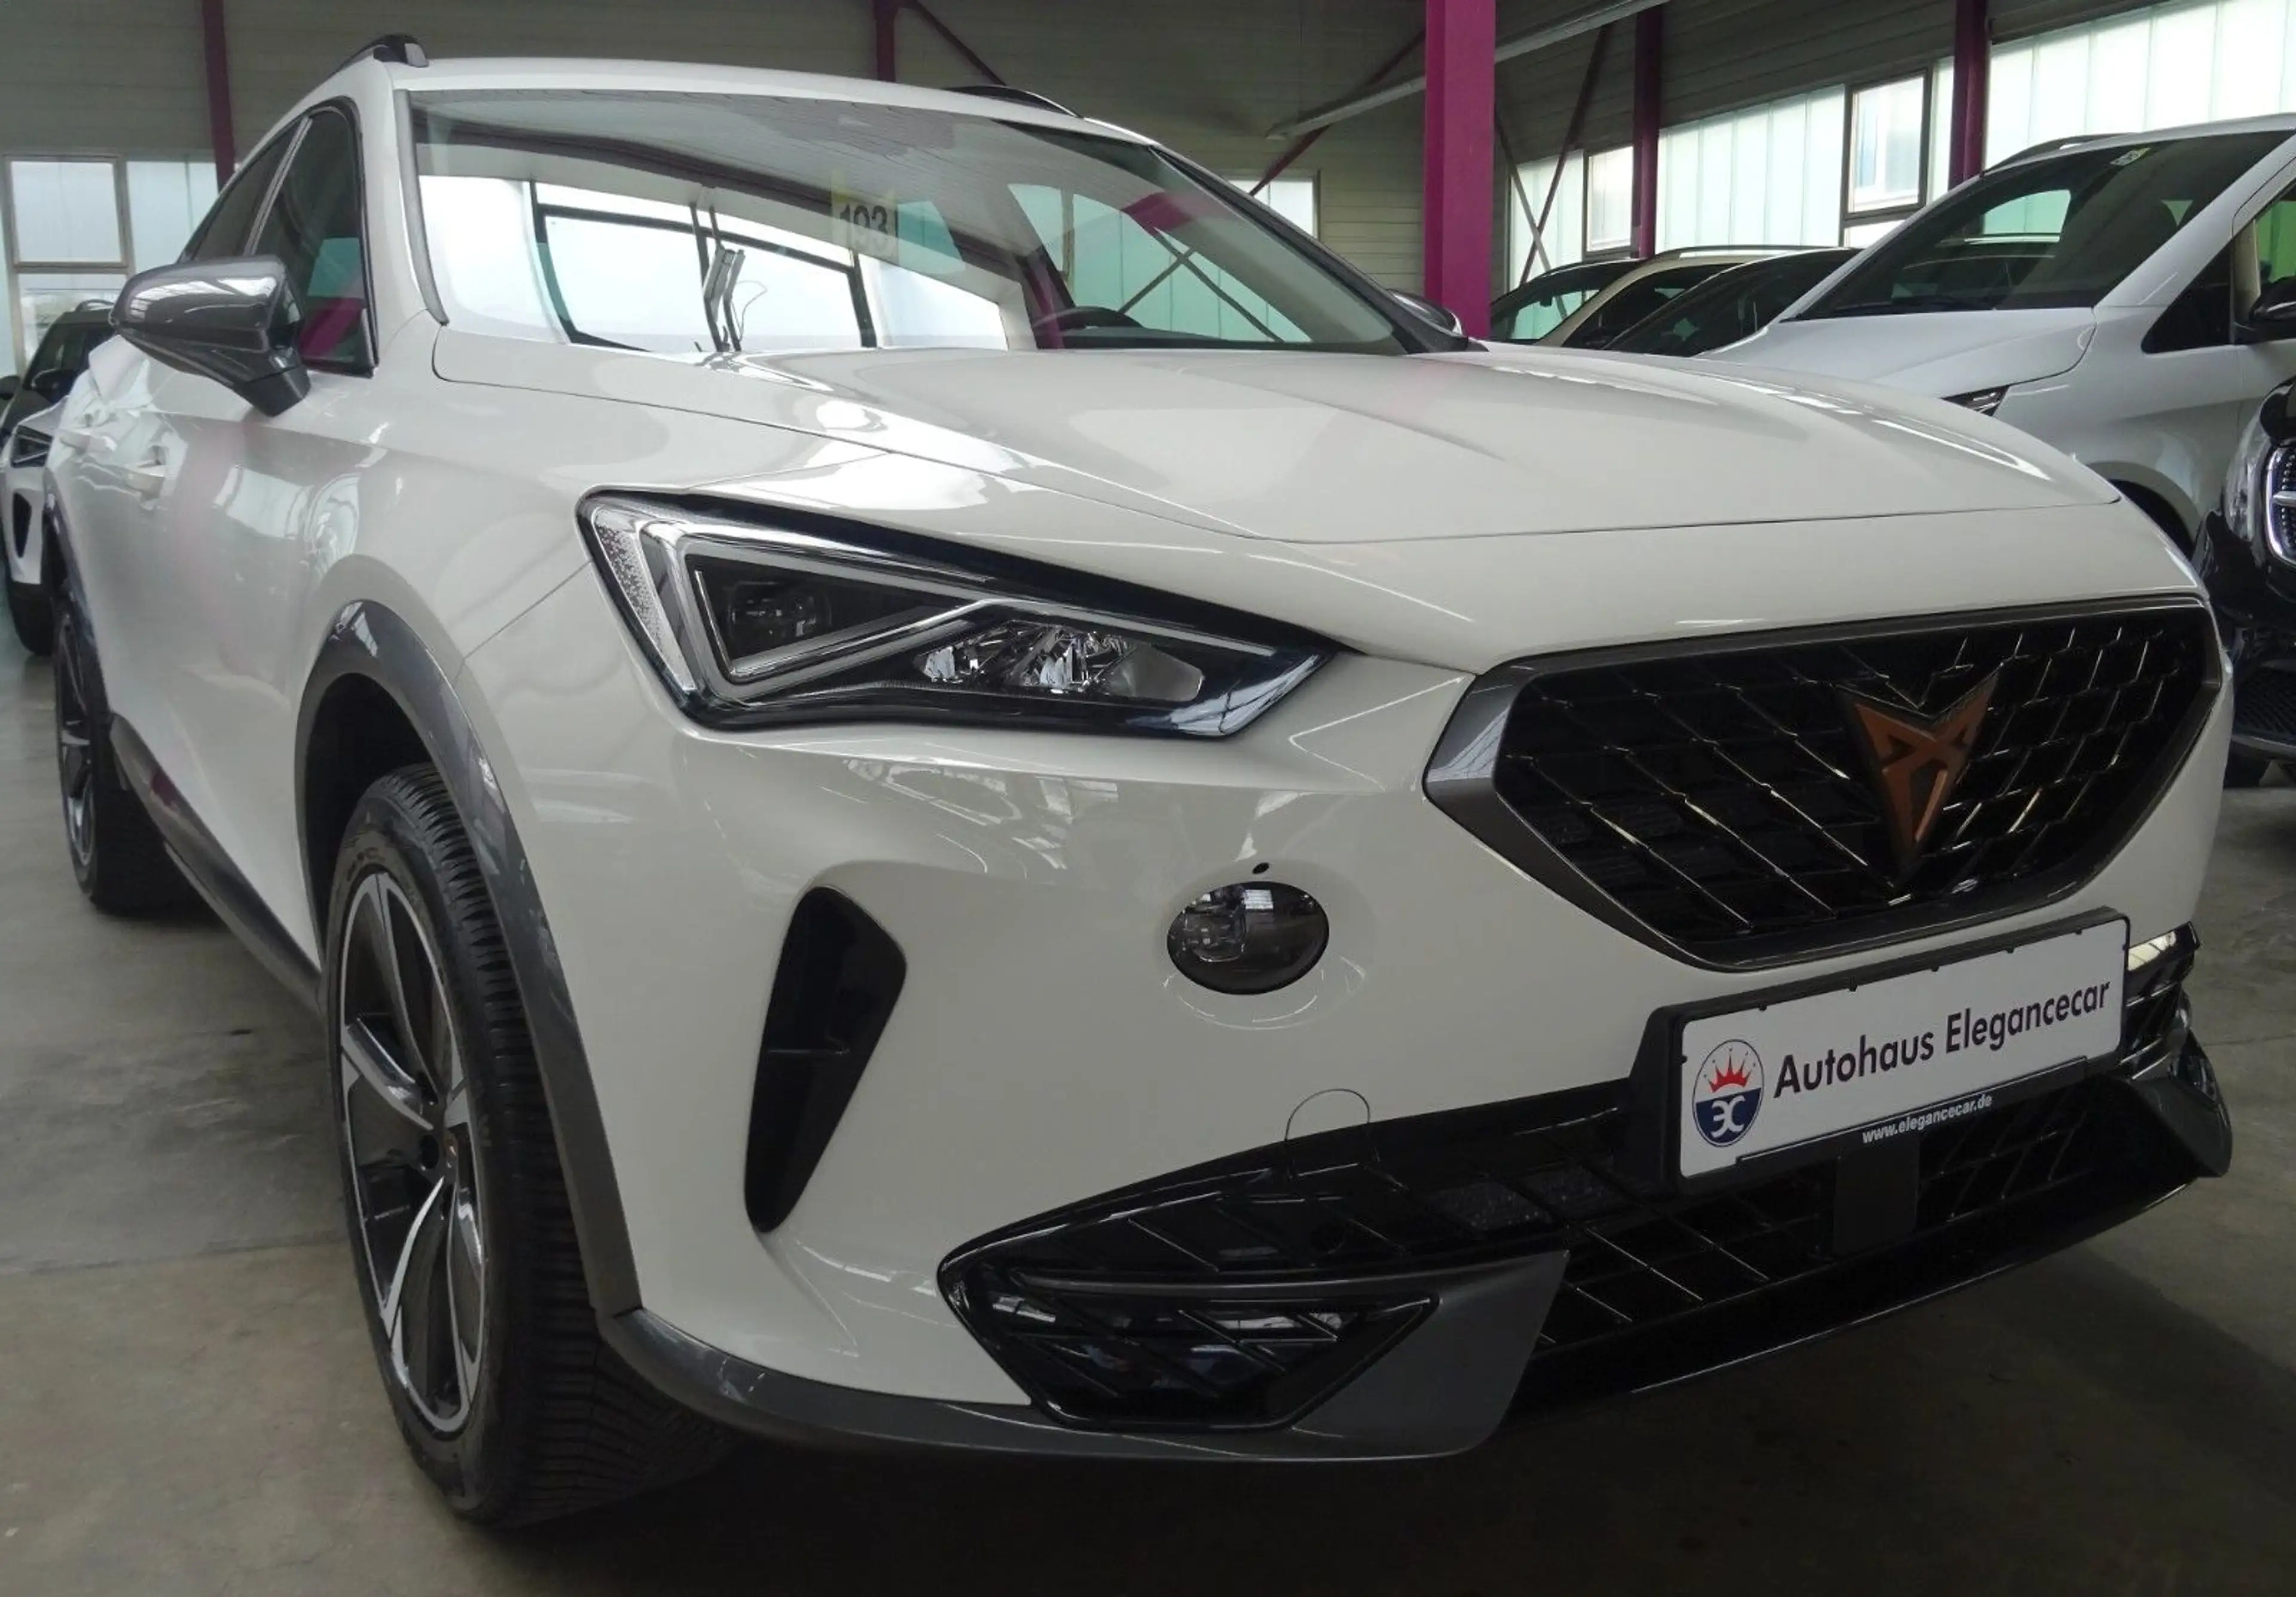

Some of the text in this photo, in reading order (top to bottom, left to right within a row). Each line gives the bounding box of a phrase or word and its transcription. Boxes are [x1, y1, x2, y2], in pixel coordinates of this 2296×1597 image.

[1773, 981, 2110, 1098] Autohaus Elegancecar
[1863, 1094, 1993, 1143] www.elegancecar.de
